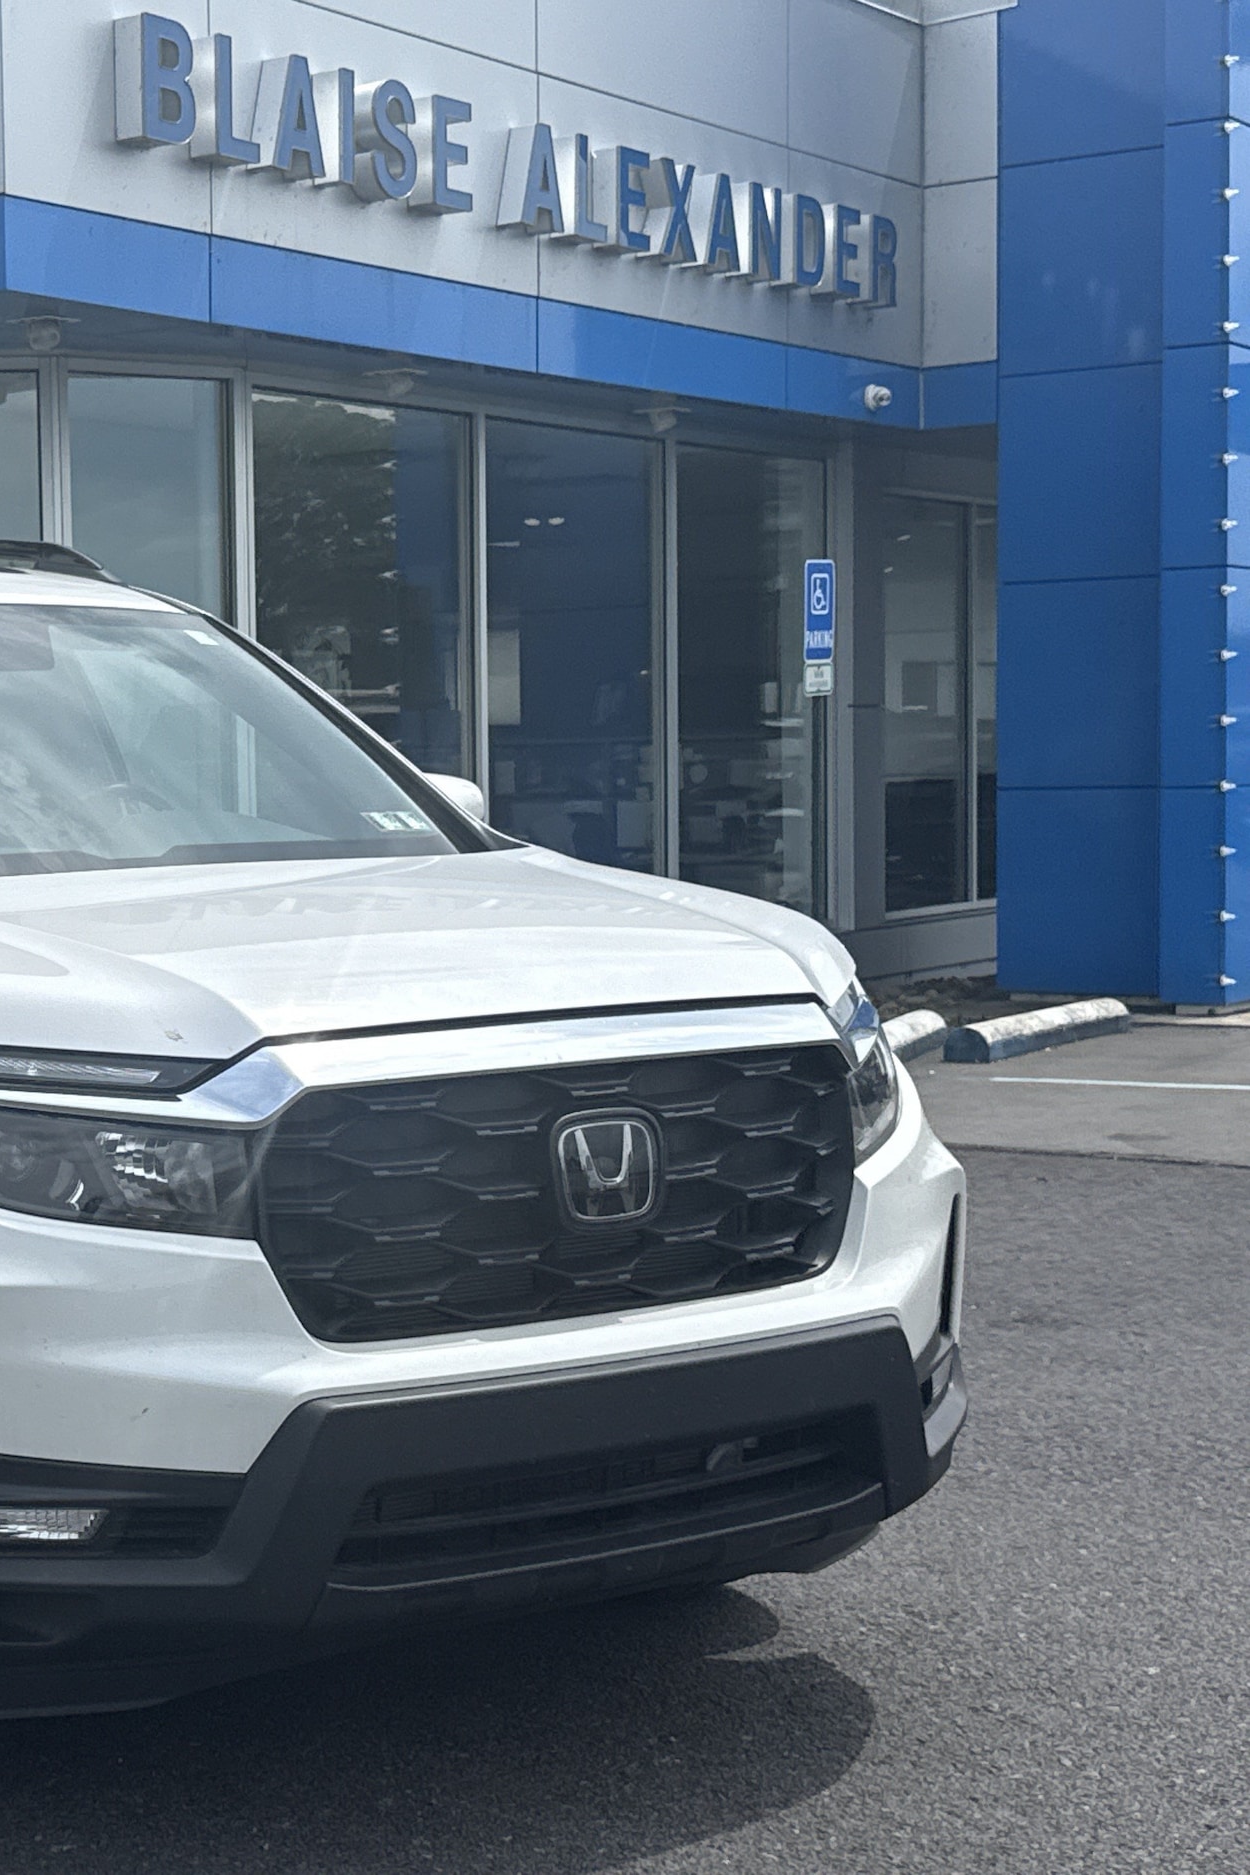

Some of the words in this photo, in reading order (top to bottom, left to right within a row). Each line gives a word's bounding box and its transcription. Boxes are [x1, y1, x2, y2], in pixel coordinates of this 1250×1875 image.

[142, 11, 473, 213] BLAISE
[522, 123, 898, 308] ALEXANDER
[805, 630, 833, 649] PARKING
